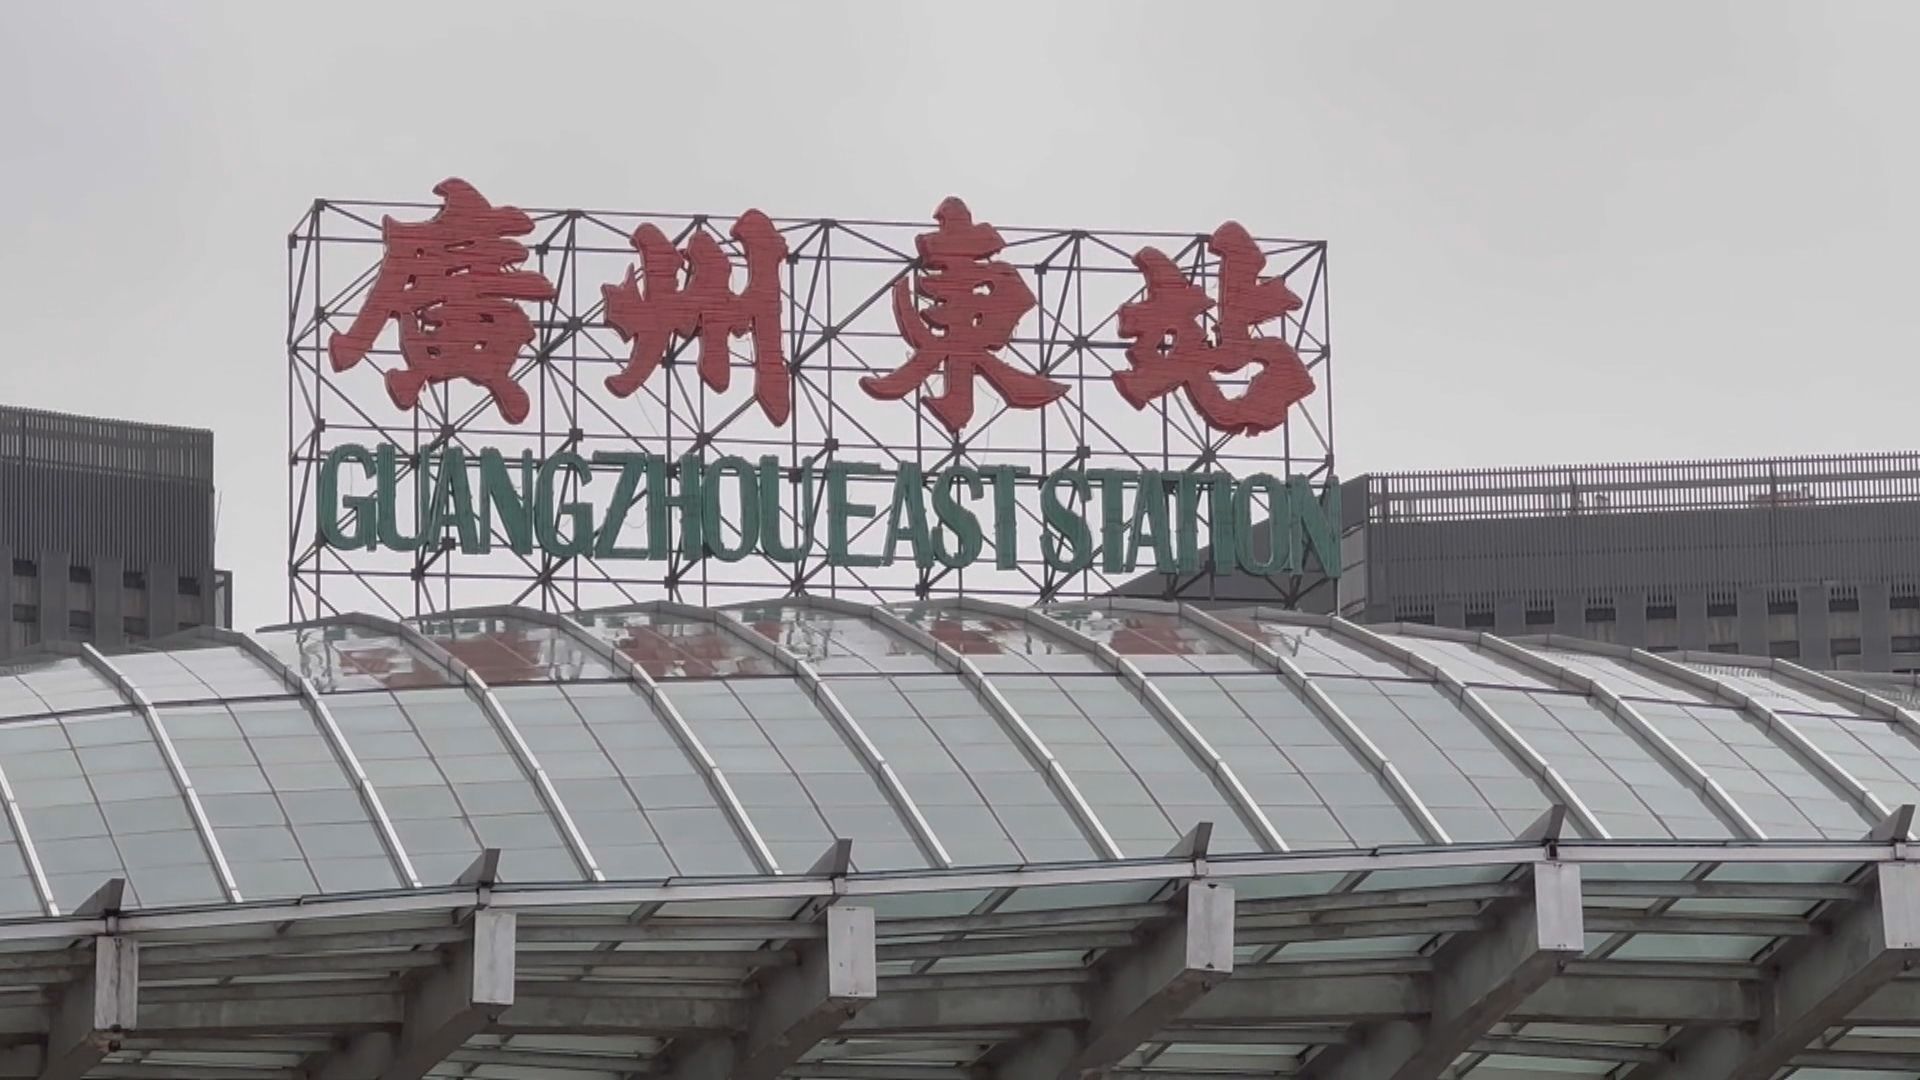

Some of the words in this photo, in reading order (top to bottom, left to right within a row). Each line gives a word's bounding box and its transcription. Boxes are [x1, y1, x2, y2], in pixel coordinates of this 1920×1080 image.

[330, 177, 1315, 436] 廣州東站
[319, 443, 813, 562] GUANGZHOU
[827, 460, 1031, 571] EAST
[1040, 467, 1342, 579] STATION
